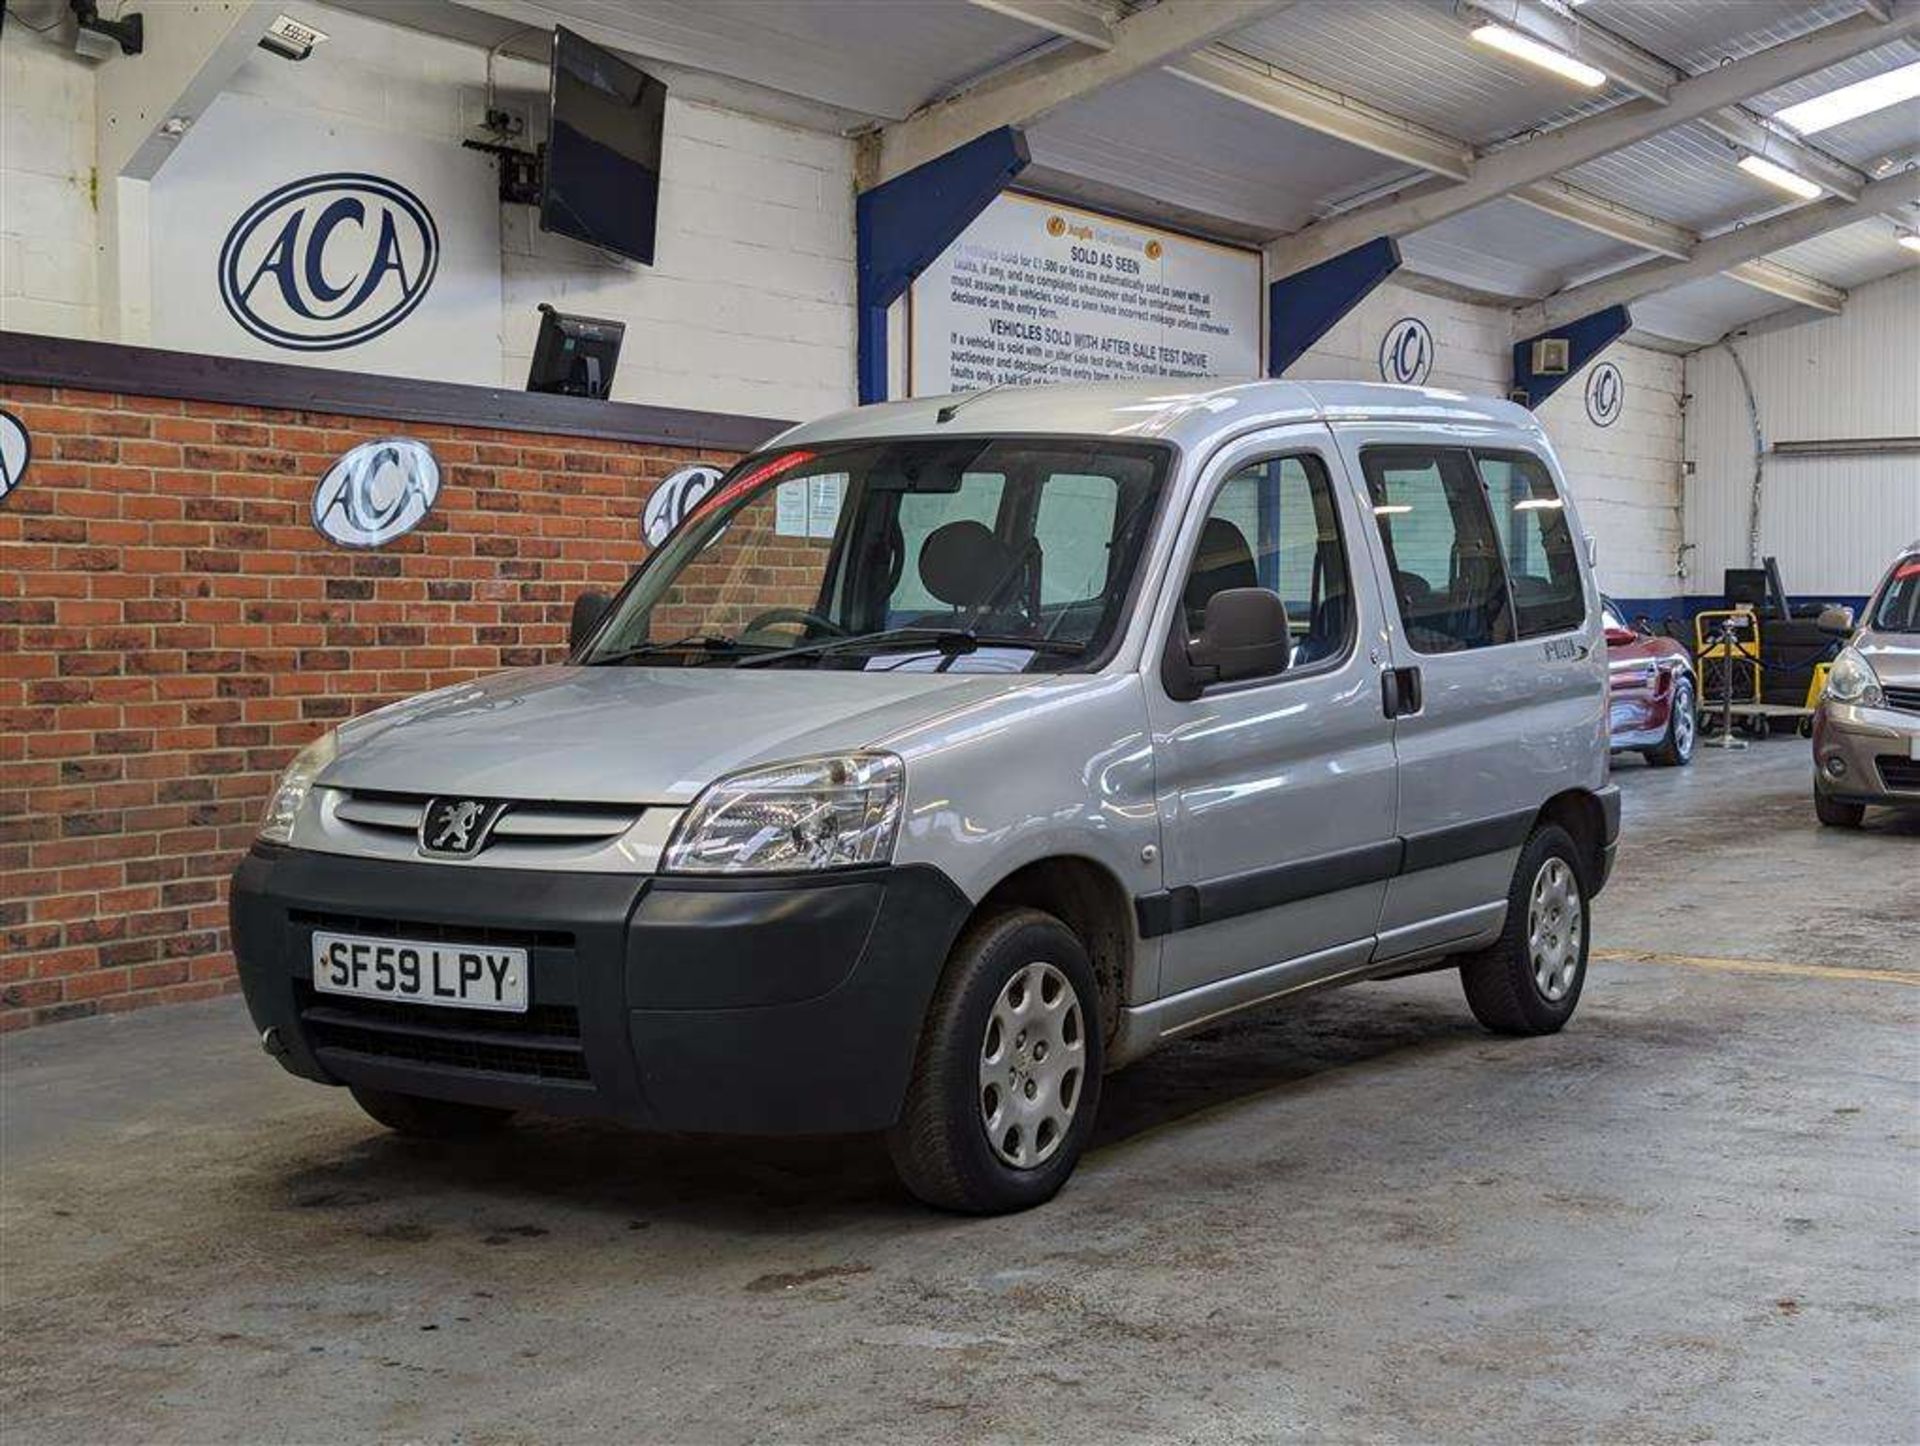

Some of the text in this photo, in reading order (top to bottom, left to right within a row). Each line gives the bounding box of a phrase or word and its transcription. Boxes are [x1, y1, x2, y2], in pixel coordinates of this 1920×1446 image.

[241, 197, 411, 320] ACA
[1070, 246, 1139, 275] SOLD AS SEEN
[951, 274, 973, 289] must
[974, 278, 1006, 295] assume
[1019, 287, 1052, 303] vehicles
[1054, 293, 1070, 306] sold
[1007, 269, 1022, 282] and
[1079, 283, 1119, 301] whatsoever
[1121, 291, 1138, 304] shall
[1060, 264, 1068, 274] or
[1069, 264, 1084, 279] less
[1100, 273, 1144, 294] automatically
[1146, 282, 1160, 295] sold
[950, 289, 987, 308] declared
[989, 298, 1000, 310] on
[1001, 299, 1015, 312] the
[1016, 303, 1037, 320] entry
[950, 350, 995, 366] auctioneer
[997, 357, 1012, 369] and
[966, 336, 995, 351] vehicle
[1007, 343, 1024, 355] sold
[989, 318, 1208, 370] VEHICLES SOLD WITH AFTER SALE TEST DRIVE
[950, 363, 974, 380] faults
[319, 447, 429, 532] ACA
[646, 472, 722, 538] AC
[329, 941, 510, 1001] SF59 LPY
